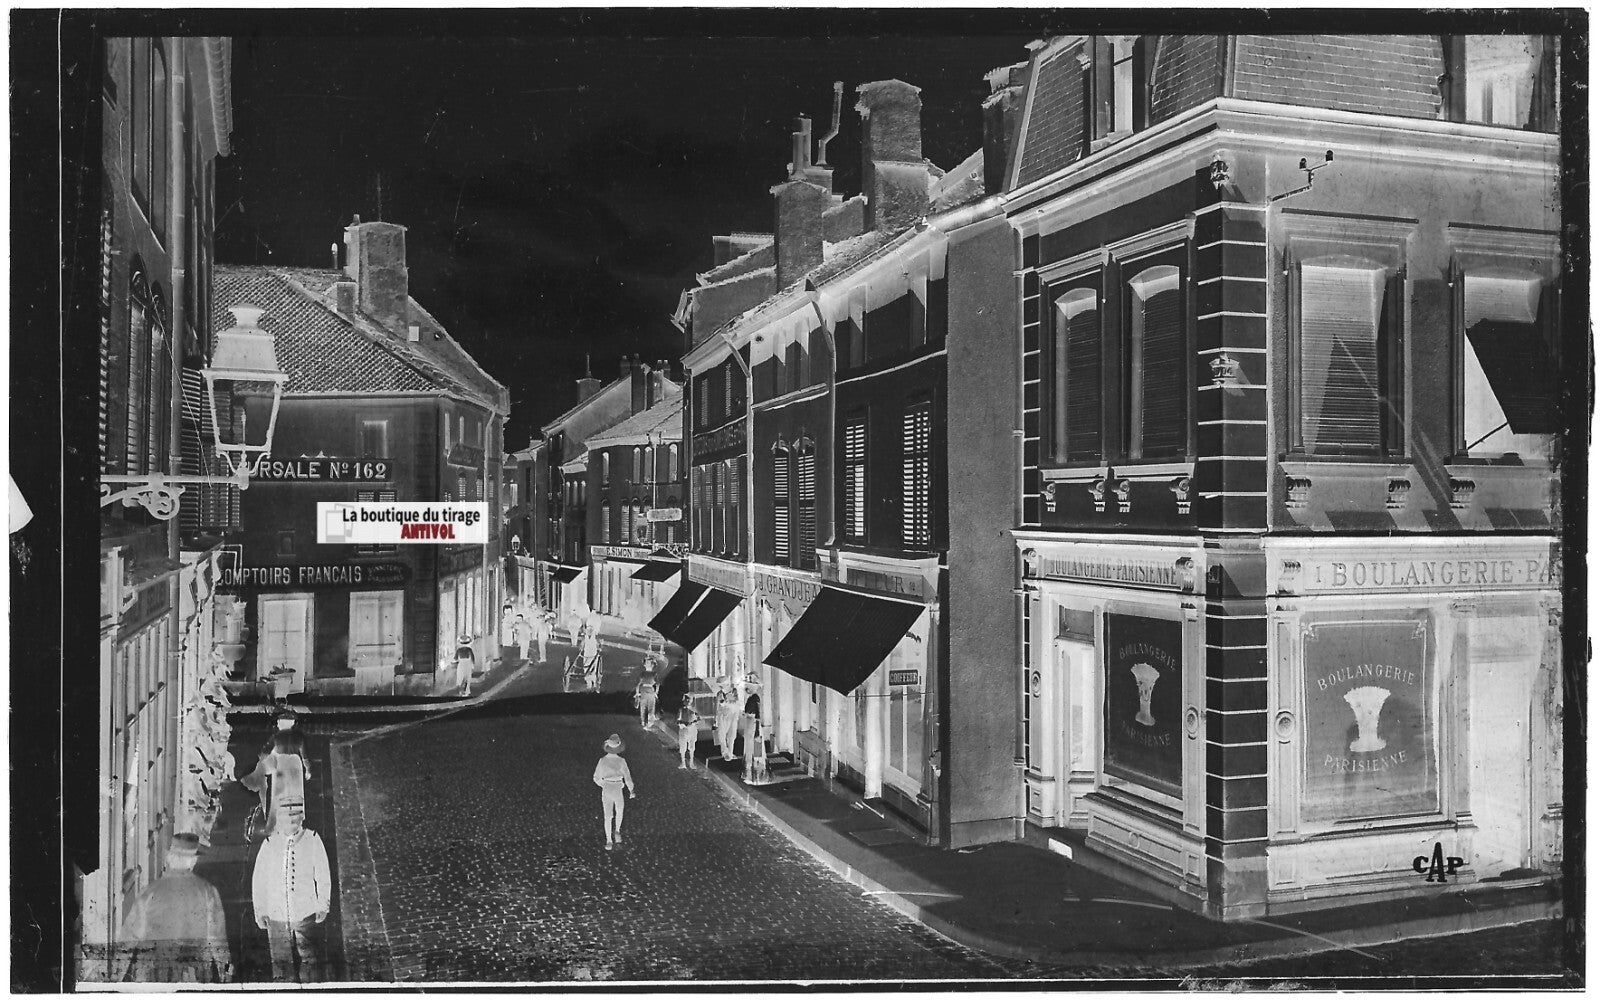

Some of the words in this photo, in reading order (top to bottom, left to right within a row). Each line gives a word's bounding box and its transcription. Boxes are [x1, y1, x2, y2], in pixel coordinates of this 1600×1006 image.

[353, 462, 387, 479] 162
[1050, 556, 1112, 579] BOULANGERIE
[1116, 559, 1177, 585] PARISIENNE
[1332, 560, 1514, 587] BOULANGERIE
[1317, 663, 1416, 691] BOULANGERIE
[1324, 750, 1408, 773] PARISIENNE
